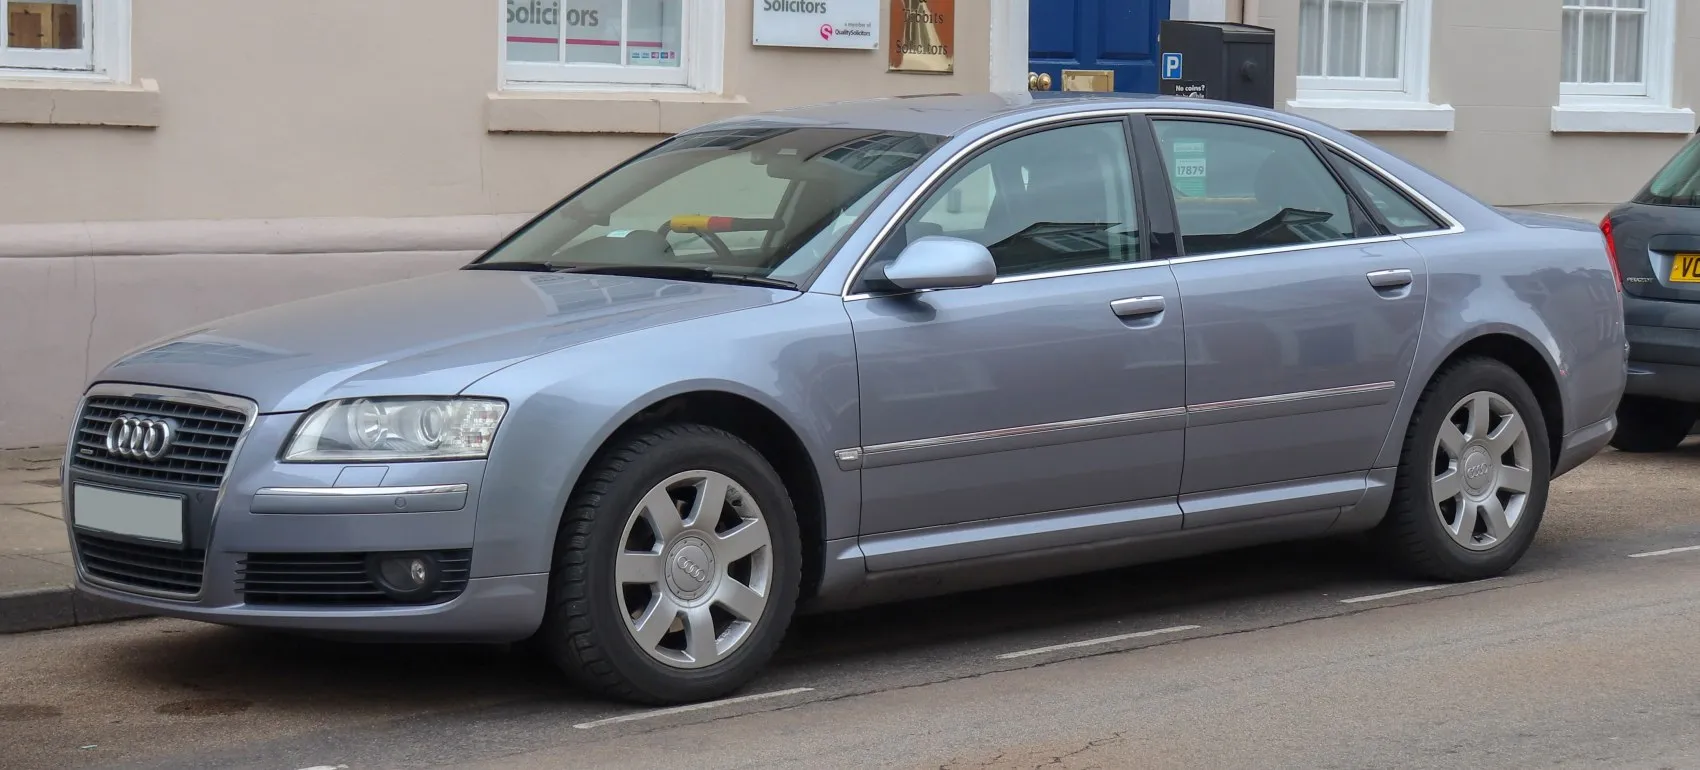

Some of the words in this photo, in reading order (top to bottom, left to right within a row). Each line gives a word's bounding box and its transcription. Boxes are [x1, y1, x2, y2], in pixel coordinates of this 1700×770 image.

[507, 0, 598, 26] Soliciors
[763, 0, 827, 14] Solicitors
[835, 28, 871, 37] QualitySolicitors
[896, 39, 948, 55] Solicitors
[1166, 56, 1179, 77] P
[1185, 84, 1206, 92] coins?
[1177, 166, 1204, 175] 17879
